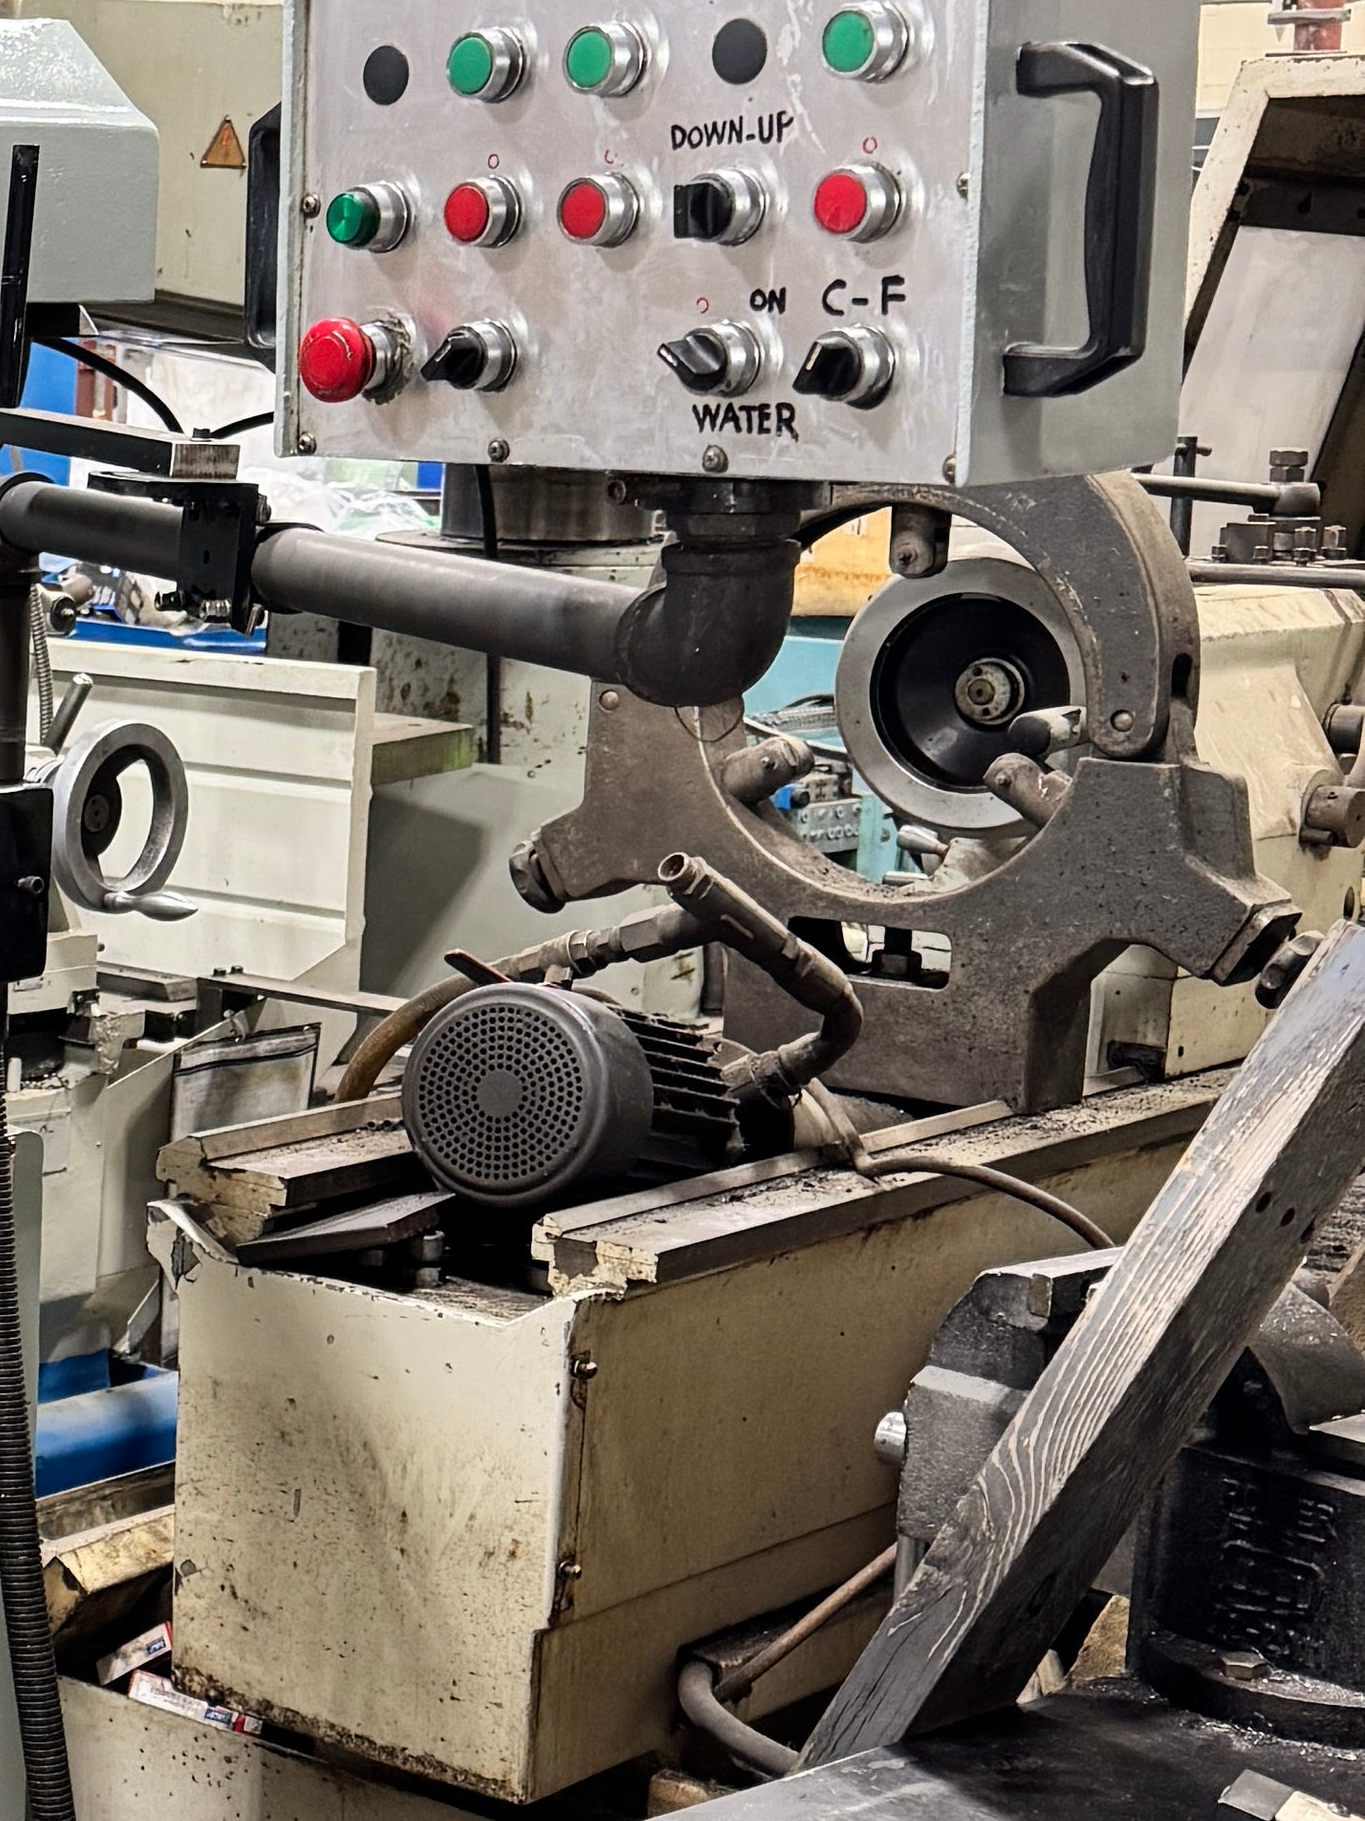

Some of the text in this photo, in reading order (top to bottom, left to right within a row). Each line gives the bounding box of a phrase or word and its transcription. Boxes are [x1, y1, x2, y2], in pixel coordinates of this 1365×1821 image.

[671, 110, 794, 151] DOWN-UP
[750, 287, 786, 314] ON
[692, 402, 799, 442] WATER
